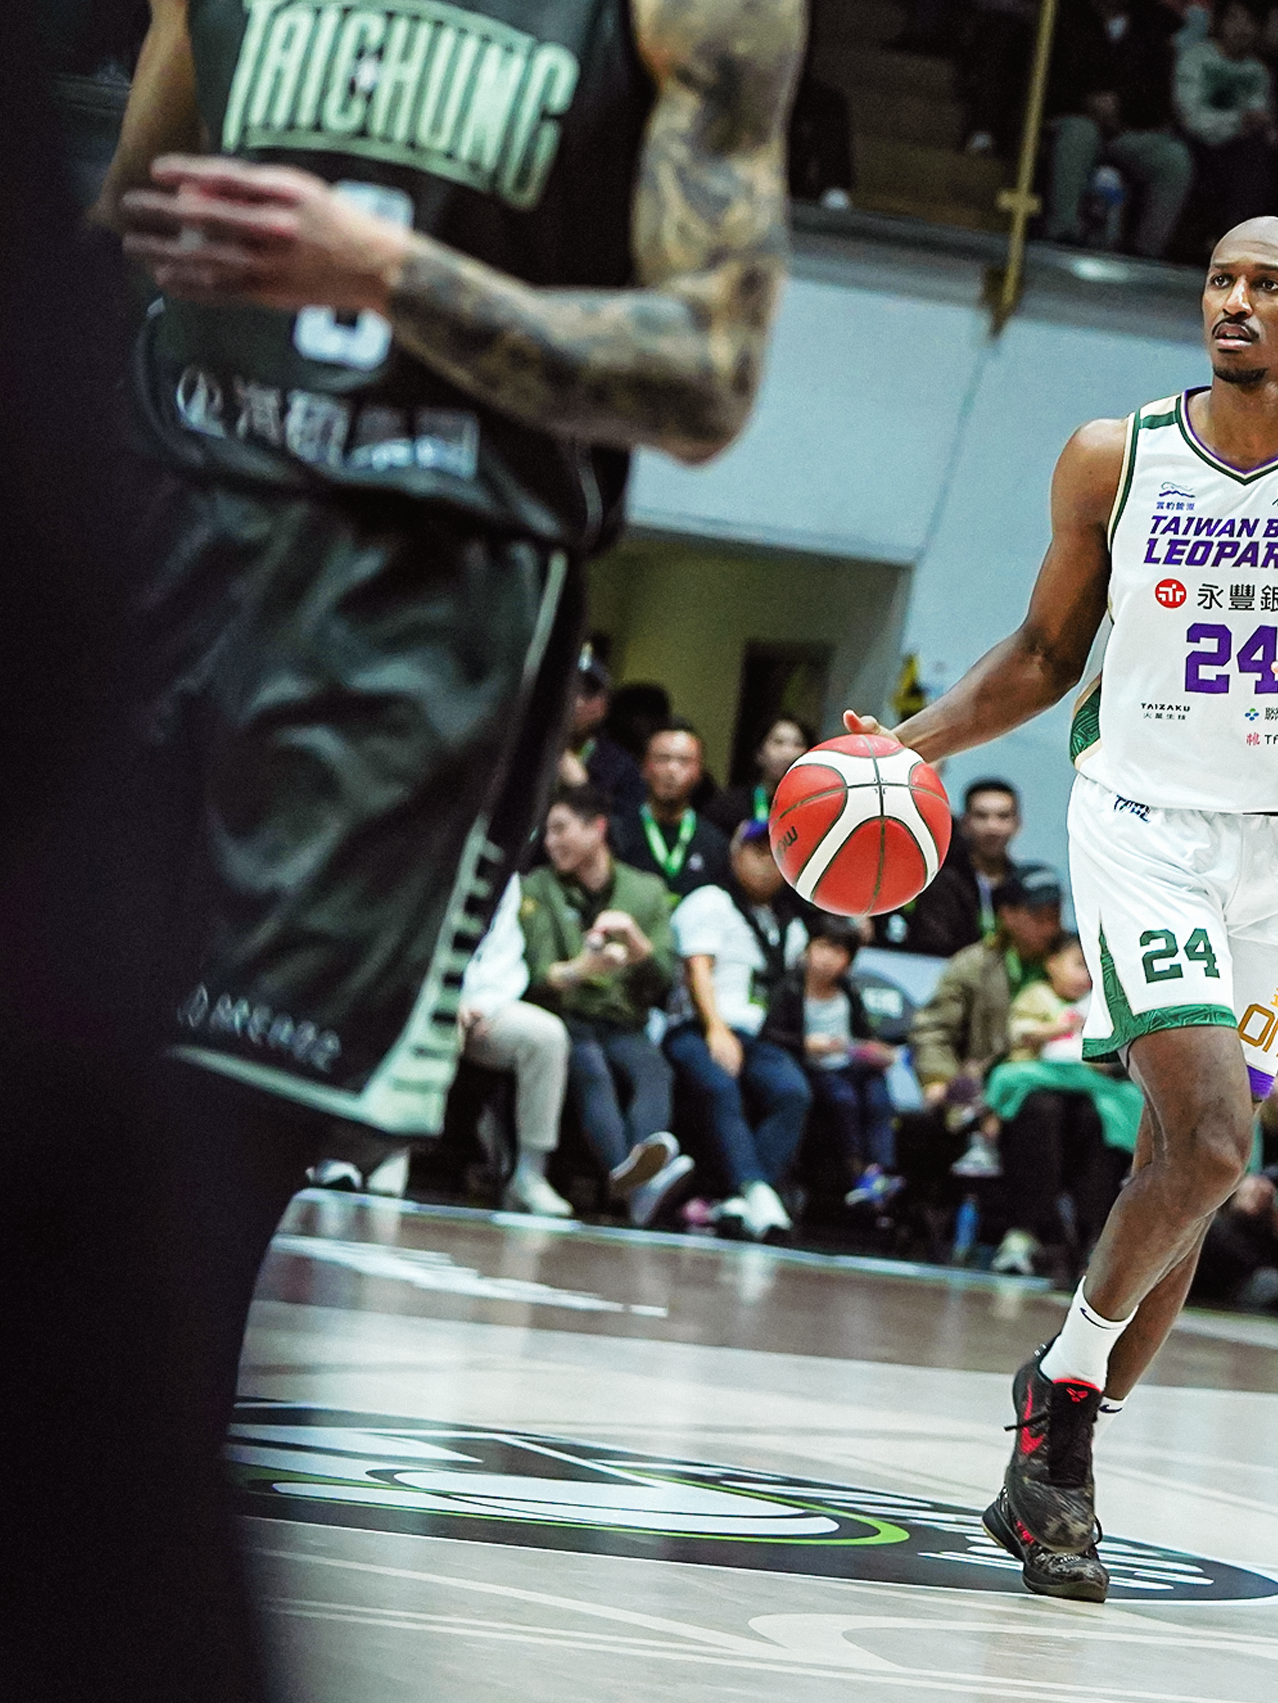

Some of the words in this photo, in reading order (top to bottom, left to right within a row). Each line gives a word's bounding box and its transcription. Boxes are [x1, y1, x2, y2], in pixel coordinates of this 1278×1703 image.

[222, 0, 580, 211] TAICHUNG
[1150, 515, 1260, 538] TAIWAN
[1140, 702, 1191, 712] TAIZAKU
[1139, 928, 1220, 984] 24
